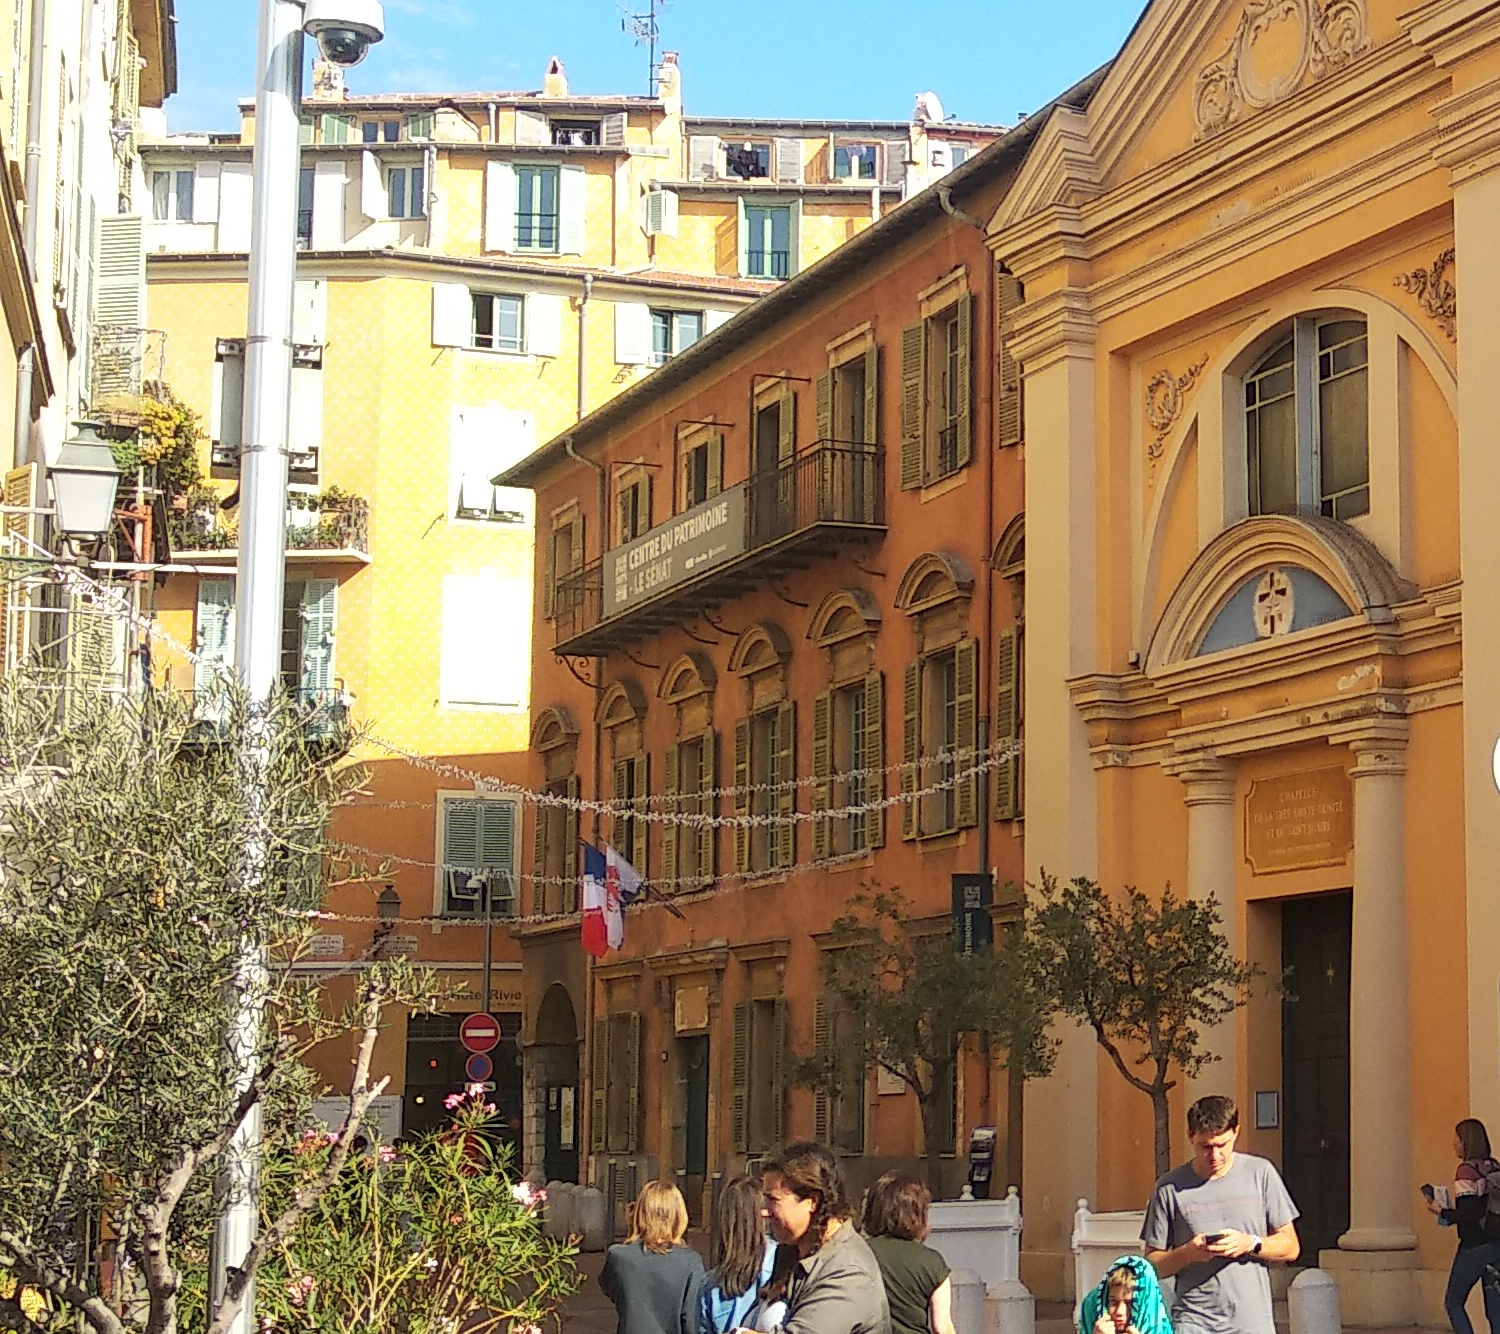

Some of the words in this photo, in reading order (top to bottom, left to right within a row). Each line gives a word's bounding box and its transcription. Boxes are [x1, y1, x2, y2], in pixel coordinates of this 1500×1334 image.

[629, 536, 660, 570] CENTRE
[661, 529, 673, 554] DU
[674, 501, 728, 547] PATRIMOINE
[634, 571, 645, 595] LE
